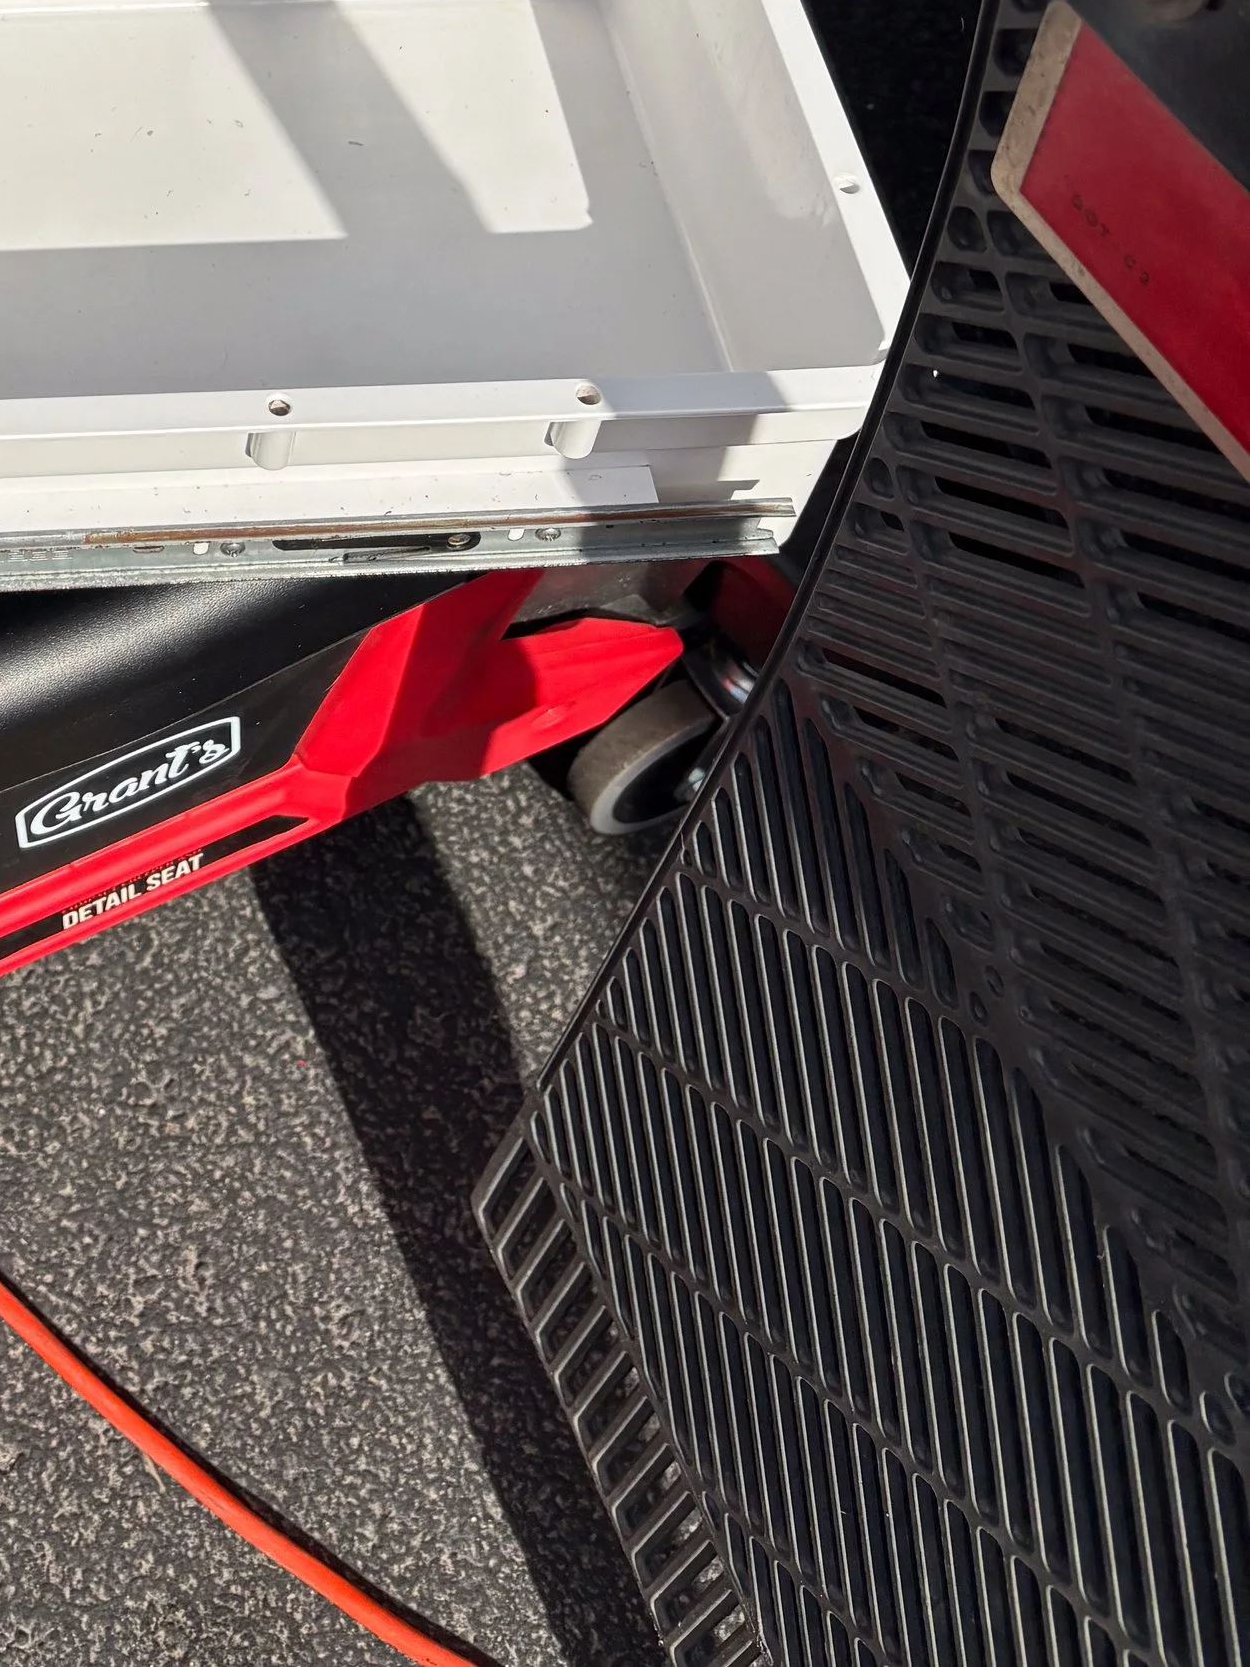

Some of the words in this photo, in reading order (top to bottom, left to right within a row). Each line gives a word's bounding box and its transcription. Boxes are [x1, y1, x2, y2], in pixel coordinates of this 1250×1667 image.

[30, 740, 230, 835] Grant's
[62, 881, 143, 930] DETAIL
[146, 852, 203, 892] SEAT
